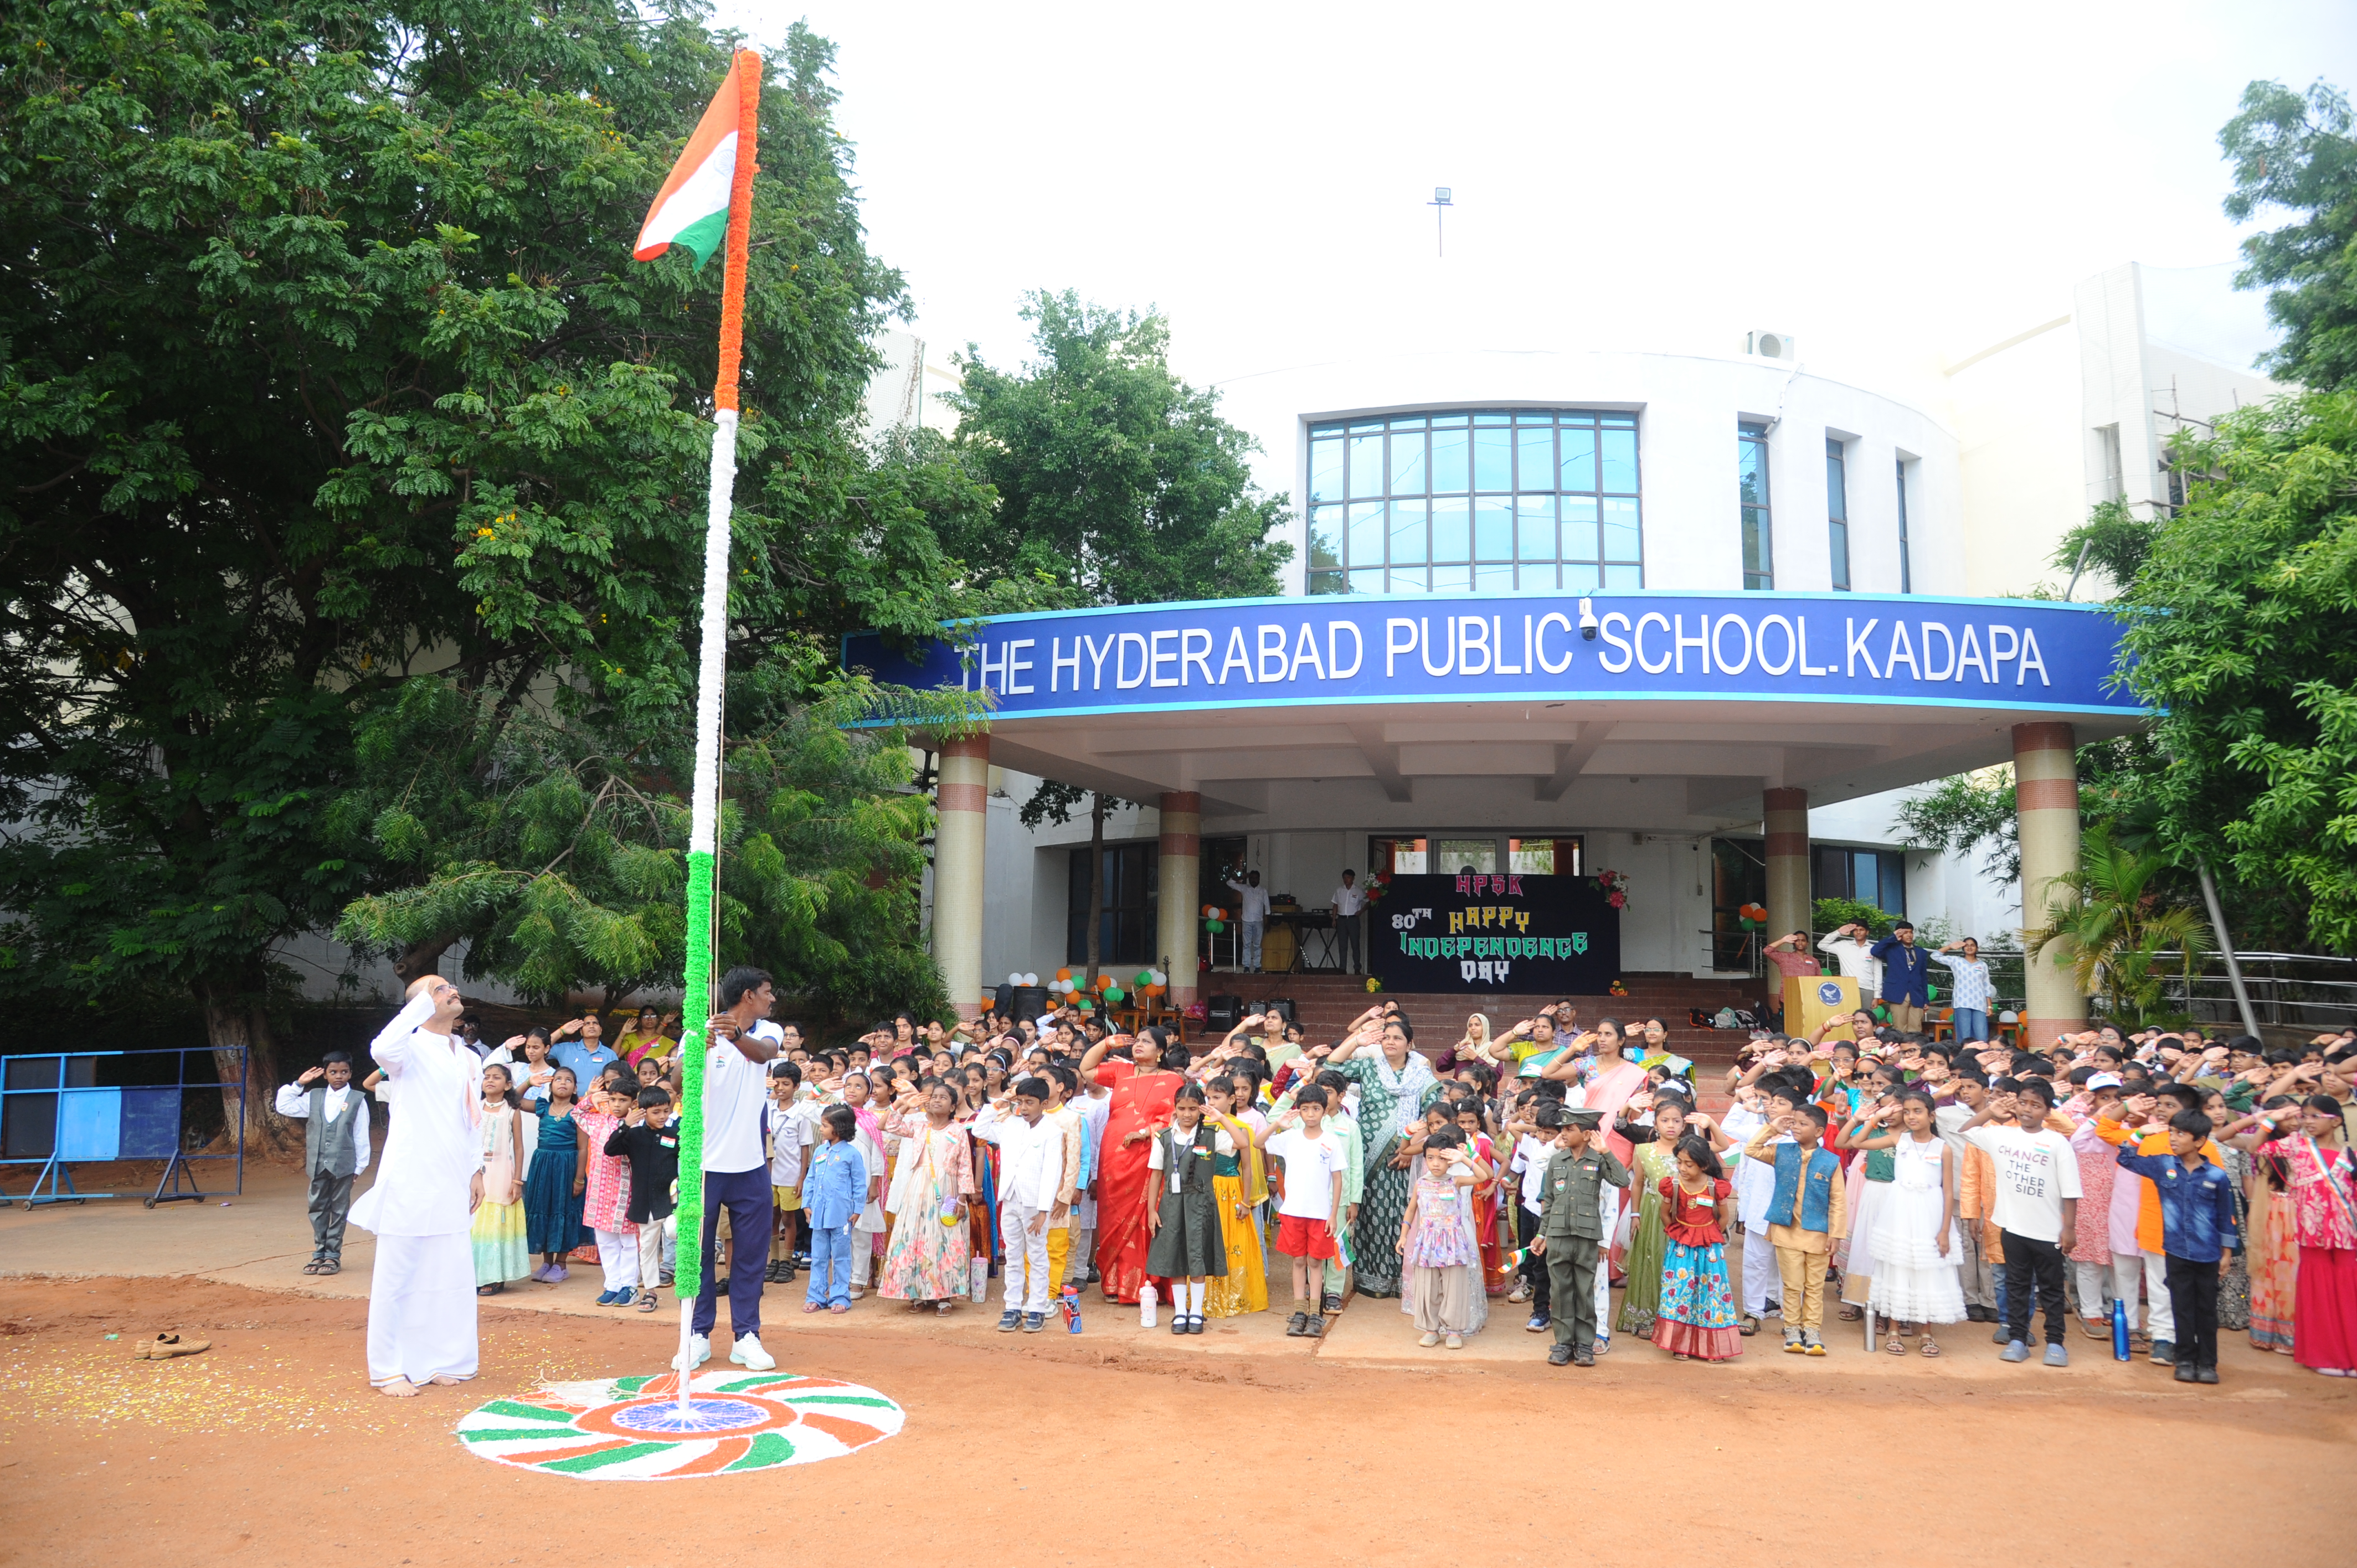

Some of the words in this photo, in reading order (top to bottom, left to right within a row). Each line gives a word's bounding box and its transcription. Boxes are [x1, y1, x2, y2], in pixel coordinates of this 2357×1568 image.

[954, 639, 1035, 695] THE
[1051, 620, 1363, 692] HYDERABAD
[1386, 612, 1573, 677] PUBLIC
[1449, 906, 1530, 934] HAPPY
[1399, 932, 1588, 961] INDEPENDENCE
[1460, 961, 1510, 984] DAY
[1999, 1145, 2049, 1166] CHANCE
[2009, 1160, 2031, 1173] THE
[2006, 1170, 2045, 1188] OTHER
[2016, 1184, 2044, 1198] SIDE
